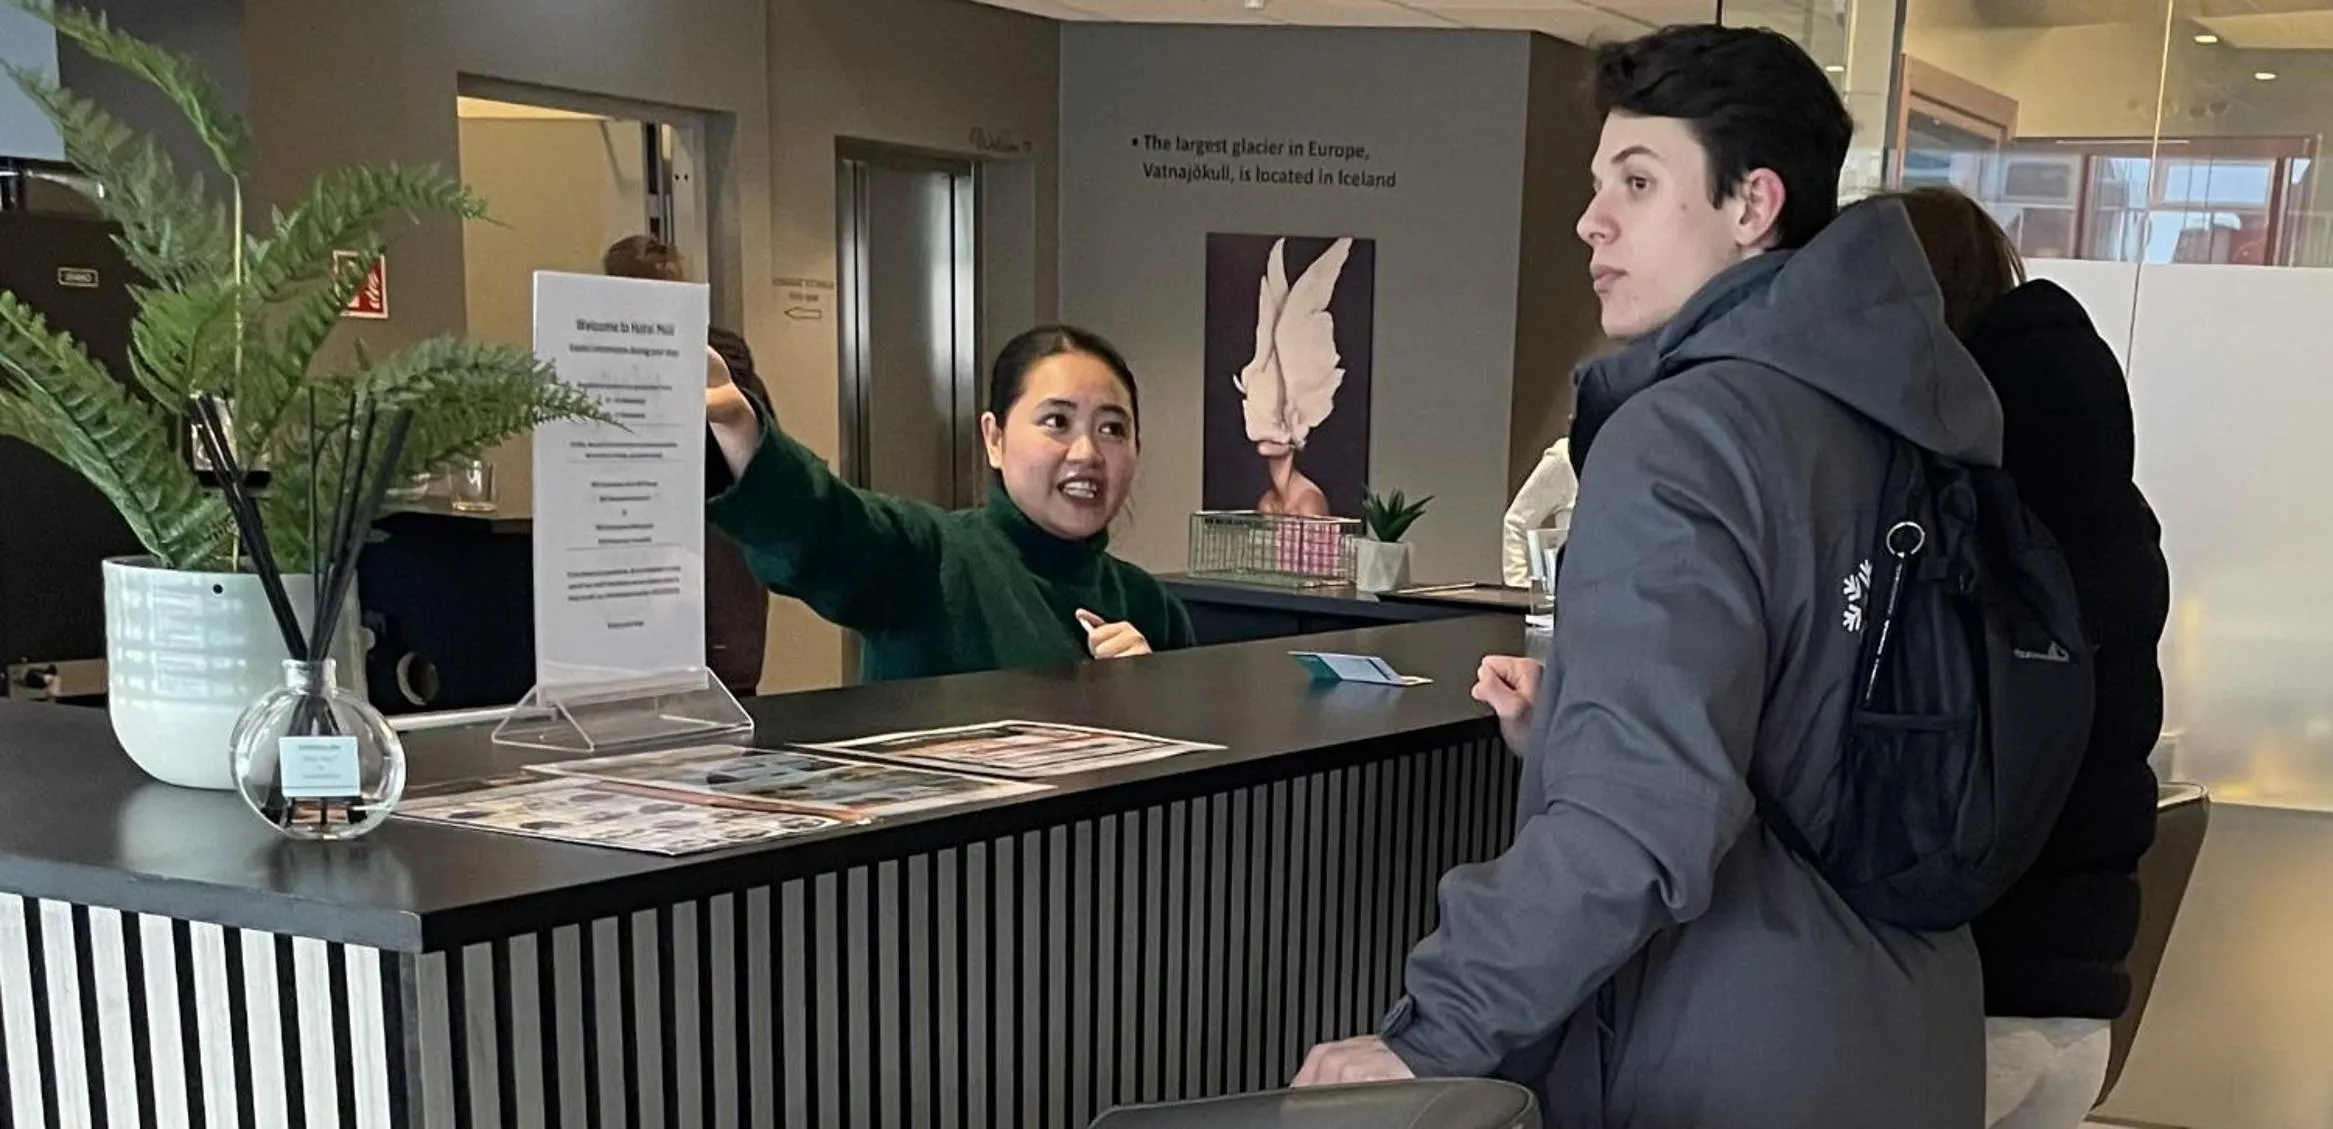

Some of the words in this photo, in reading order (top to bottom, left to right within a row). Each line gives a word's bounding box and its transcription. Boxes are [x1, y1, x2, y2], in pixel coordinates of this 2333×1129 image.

[1144, 134, 1171, 152] The
[1176, 136, 1227, 157] largest
[1232, 138, 1284, 157] glacier
[1289, 138, 1303, 155] in
[1308, 141, 1370, 162] Europe,
[1143, 163, 1234, 184] Vatnajökull,
[1240, 166, 1251, 182] is
[1256, 167, 1314, 184] located
[1319, 168, 1334, 186] in
[1339, 170, 1396, 188] Iceland
